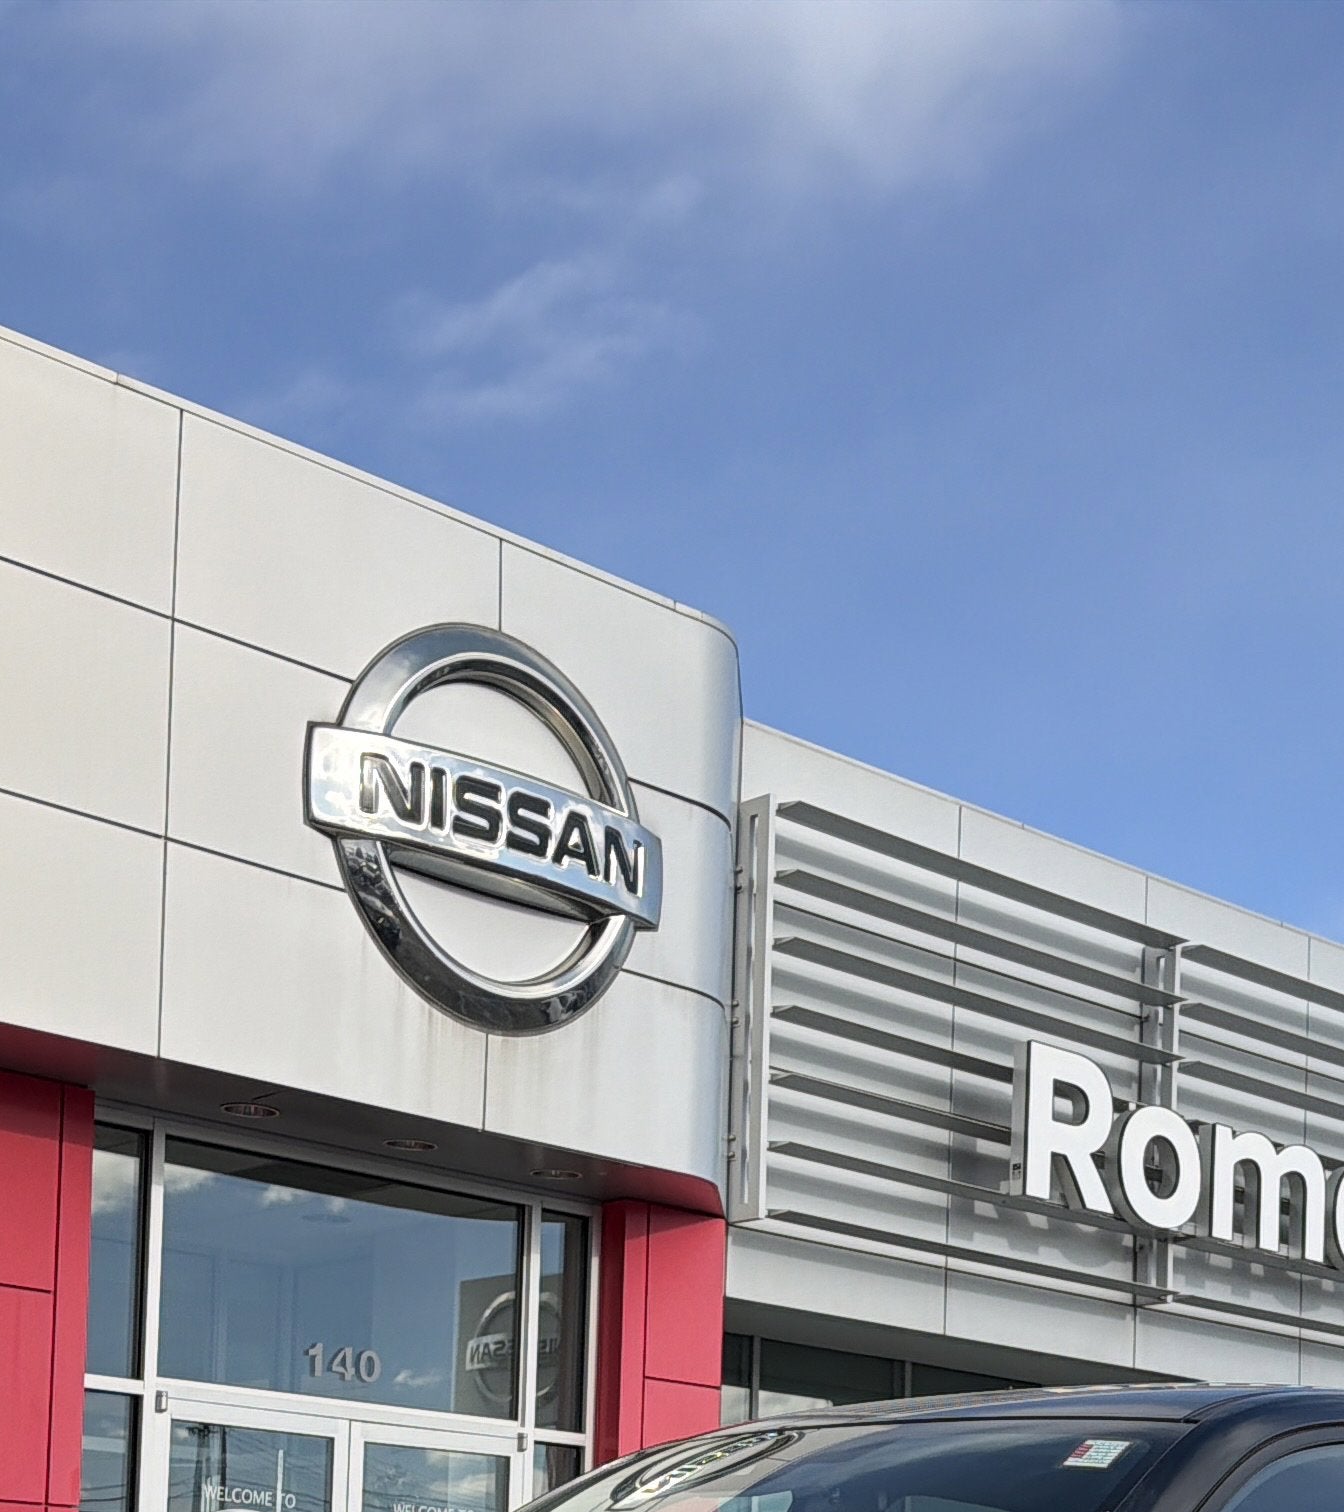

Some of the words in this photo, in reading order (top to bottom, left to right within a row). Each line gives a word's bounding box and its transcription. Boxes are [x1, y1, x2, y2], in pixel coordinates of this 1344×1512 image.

[359, 751, 646, 898] NISSAN
[306, 1342, 382, 1383] 140
[202, 1483, 273, 1507] WELCOME
[277, 1492, 297, 1509] TO
